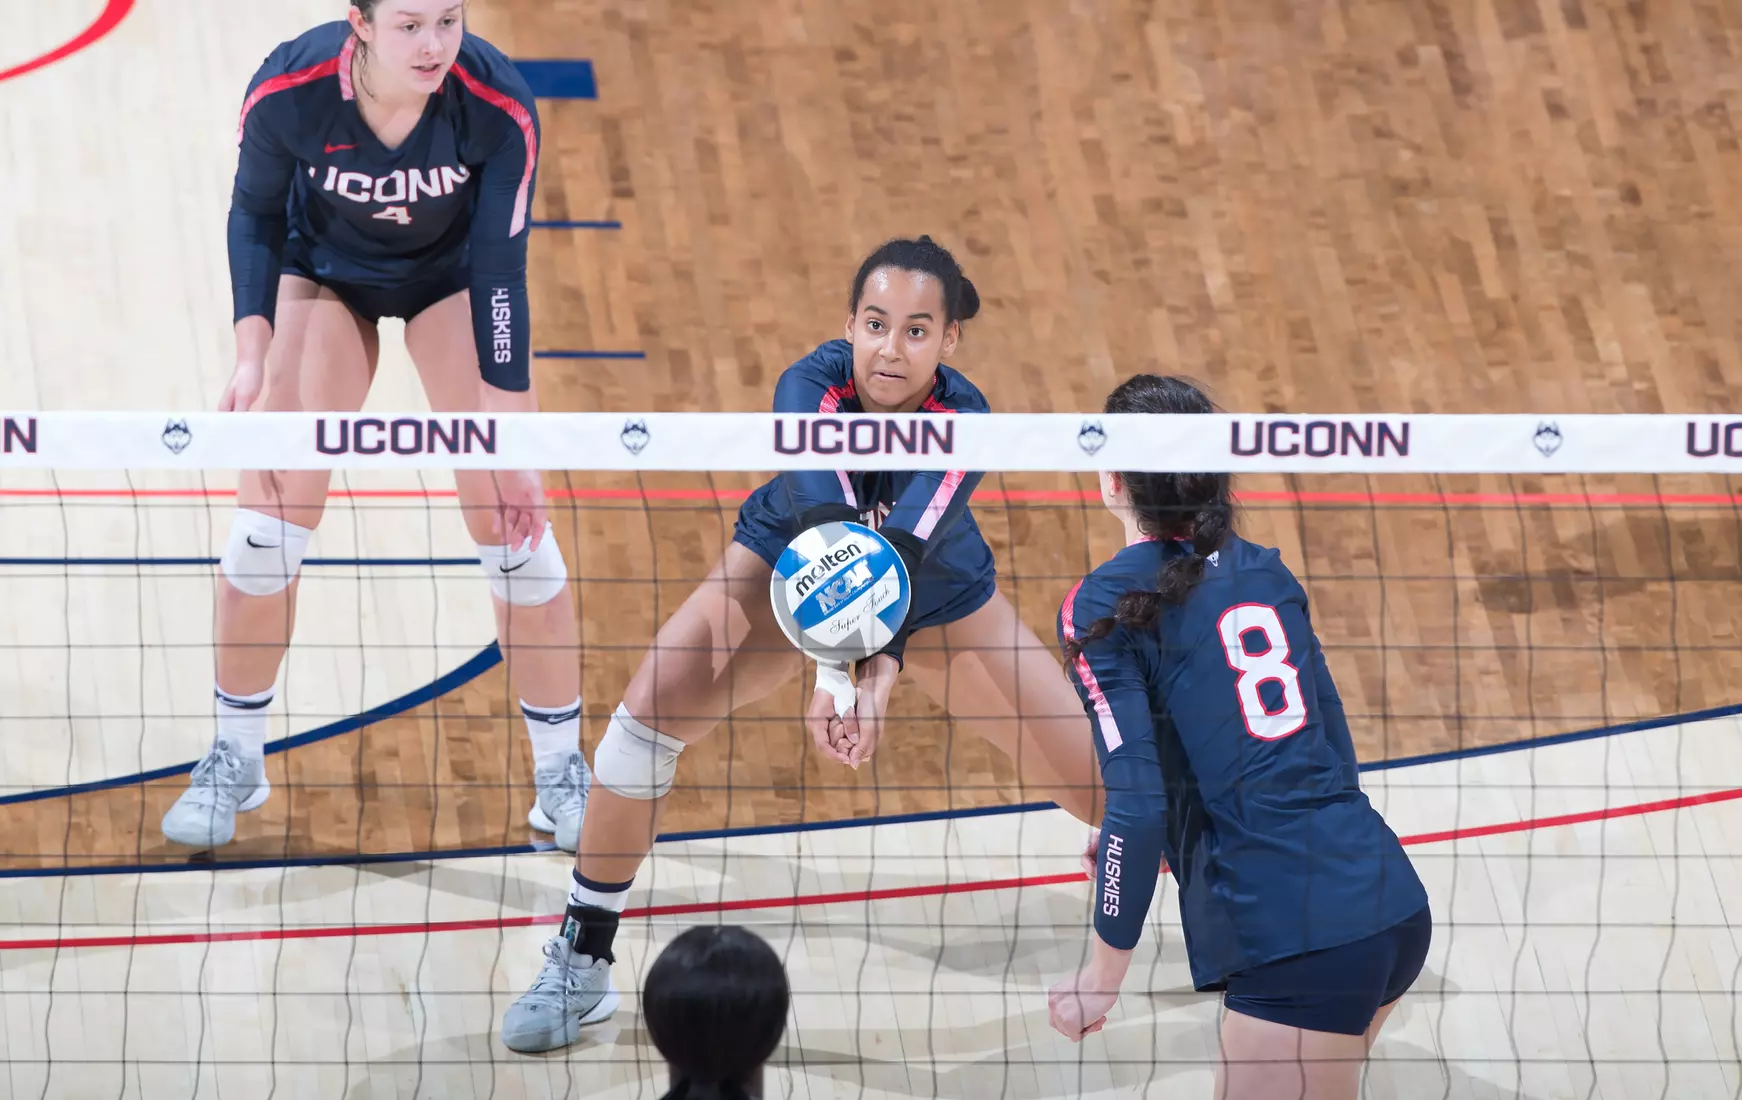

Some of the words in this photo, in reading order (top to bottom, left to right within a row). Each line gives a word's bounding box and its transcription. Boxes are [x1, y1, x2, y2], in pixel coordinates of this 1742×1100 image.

[371, 205, 413, 225] 4
[491, 287, 512, 364] HUSKIES
[316, 417, 497, 456] UCONN
[773, 418, 955, 456] UCONN
[1230, 420, 1410, 457] UCONN
[795, 543, 862, 598] molten
[829, 612, 861, 635] Super
[862, 583, 891, 613] Touch
[1215, 601, 1308, 742] 8
[1103, 833, 1124, 918] HUSKIES
